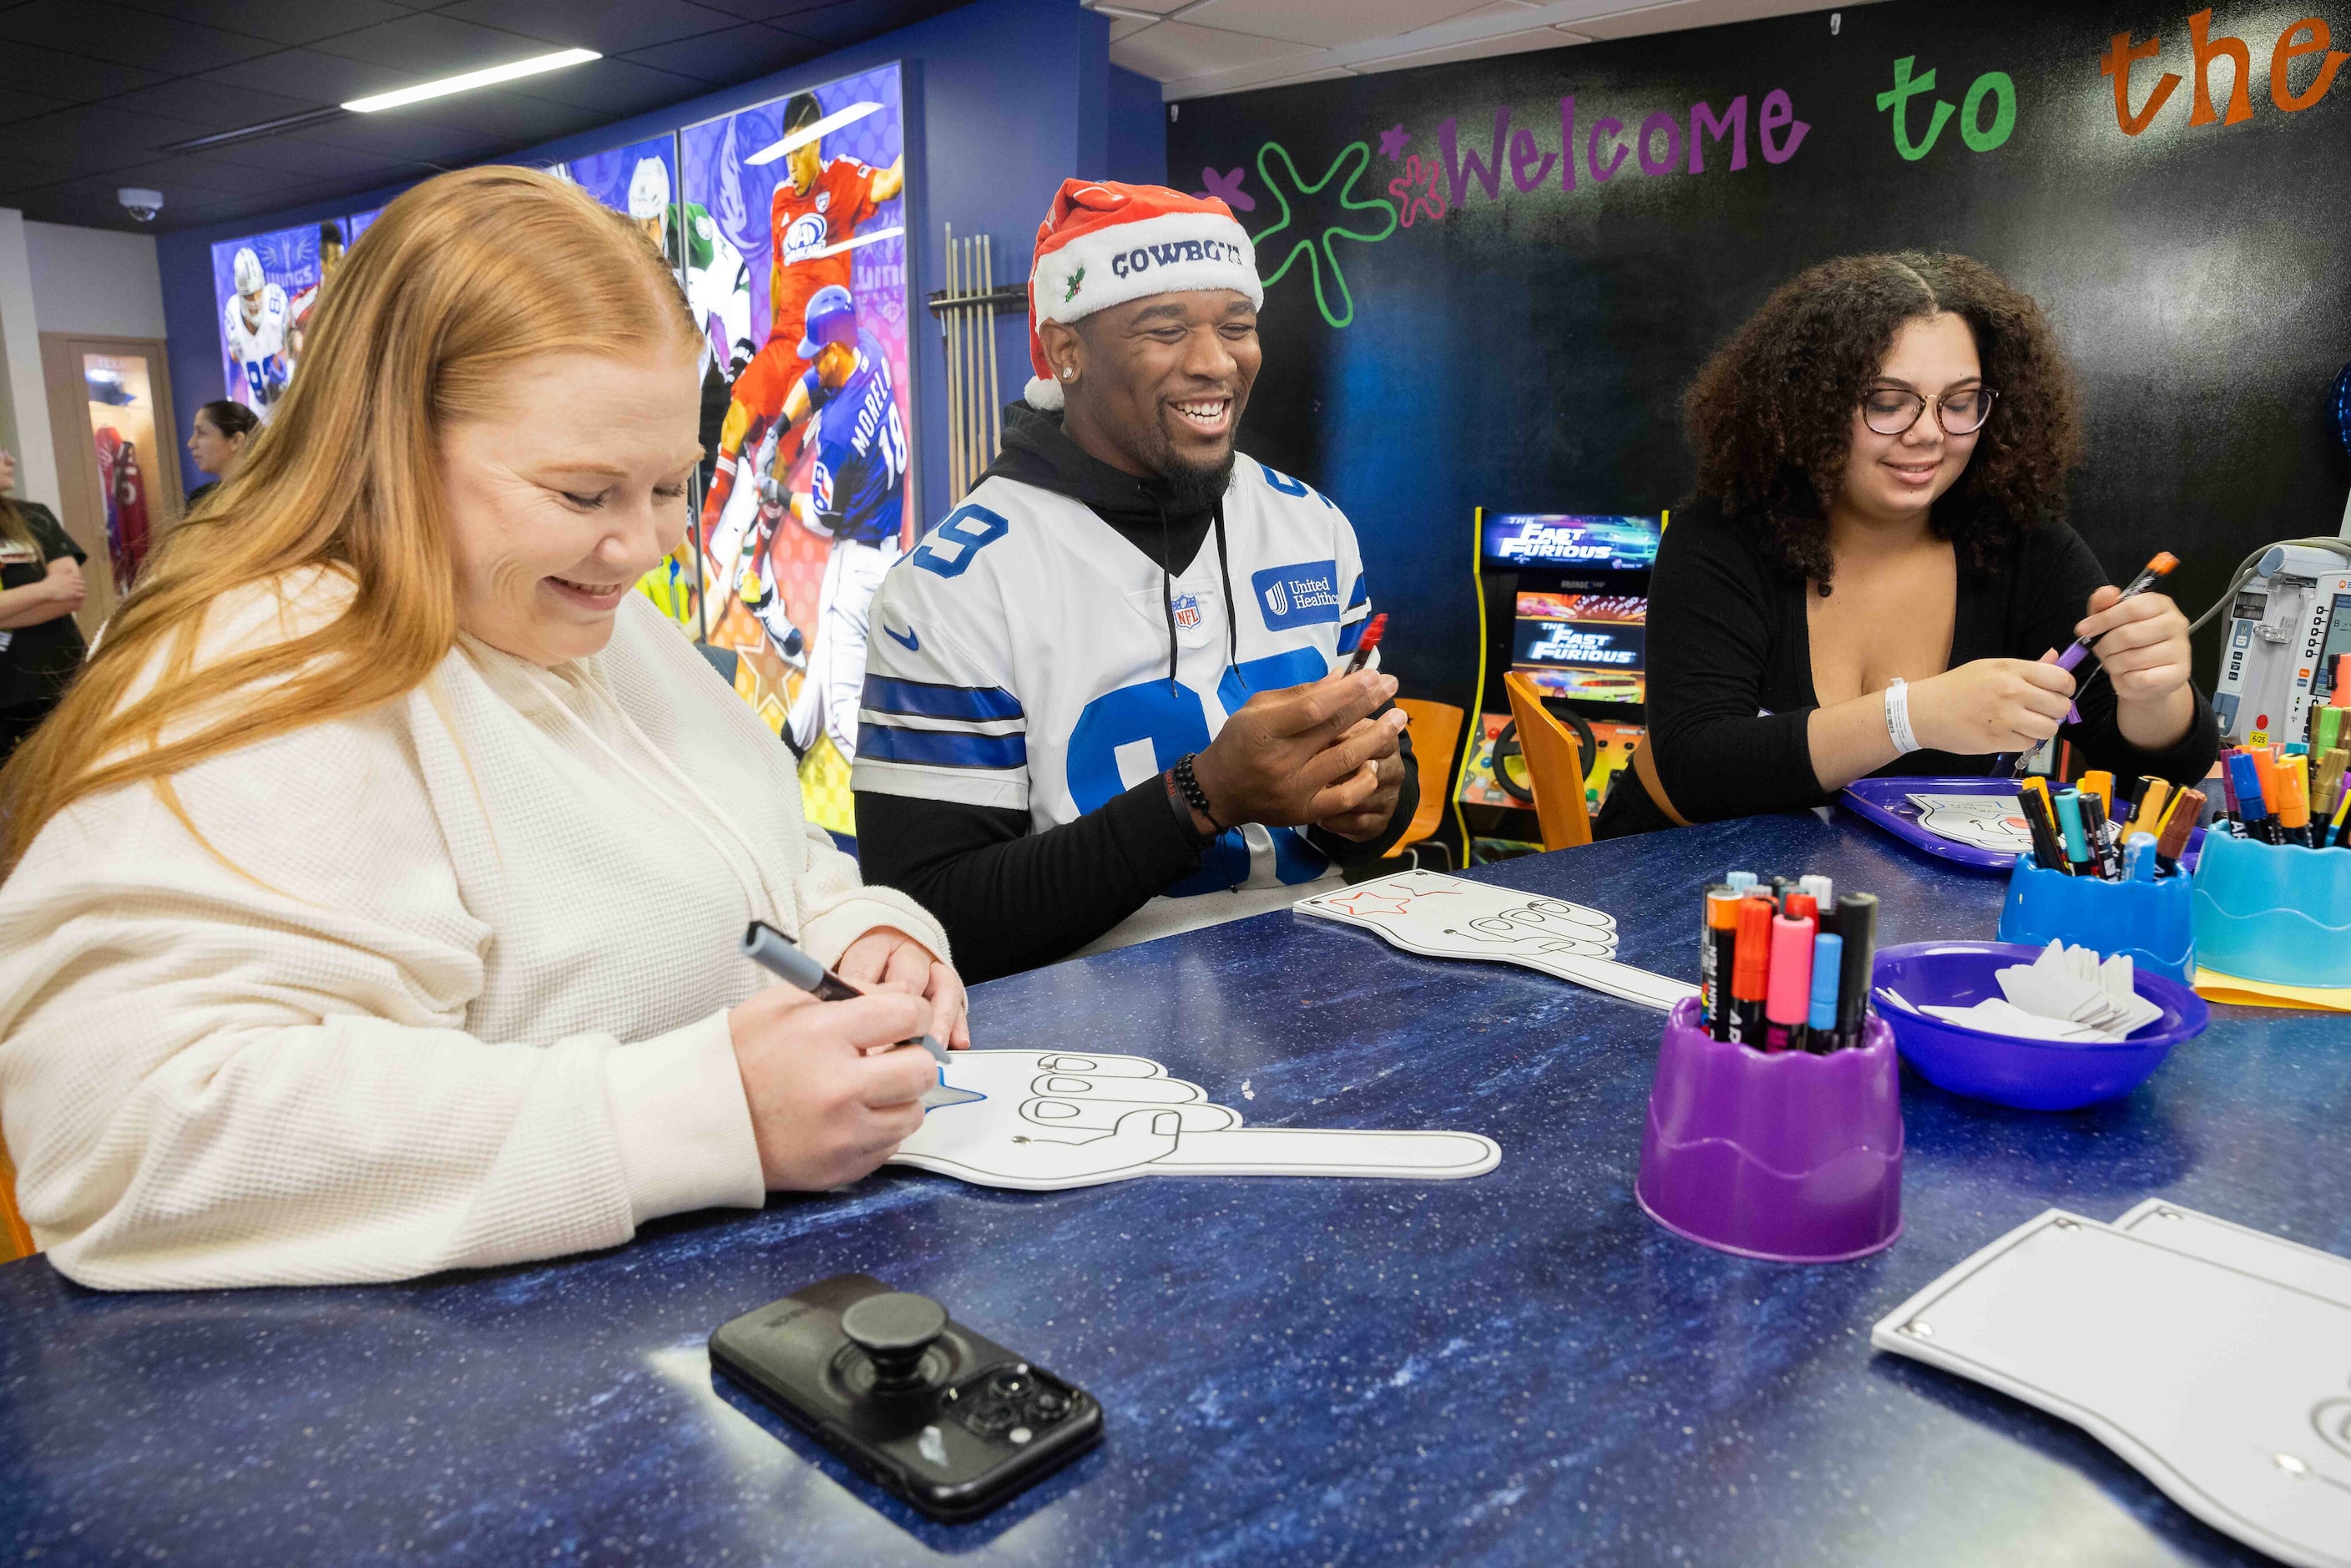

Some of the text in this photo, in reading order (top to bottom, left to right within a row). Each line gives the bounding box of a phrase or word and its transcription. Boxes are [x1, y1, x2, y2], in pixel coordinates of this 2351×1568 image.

[1877, 55, 2016, 160] to
[2101, 8, 2350, 136] the
[1112, 240, 1242, 279] COWBO
[878, 402, 908, 491] 18
[1520, 524, 1586, 541] FAST
[1499, 538, 1612, 559] FURIOUS
[1288, 577, 1330, 594] United
[1177, 608, 1199, 626] NFL
[1541, 622, 1566, 630] THE
[1551, 630, 1610, 646] FAST
[1530, 641, 1633, 663] FURIOUS
[2252, 735, 2266, 744] 6/25
